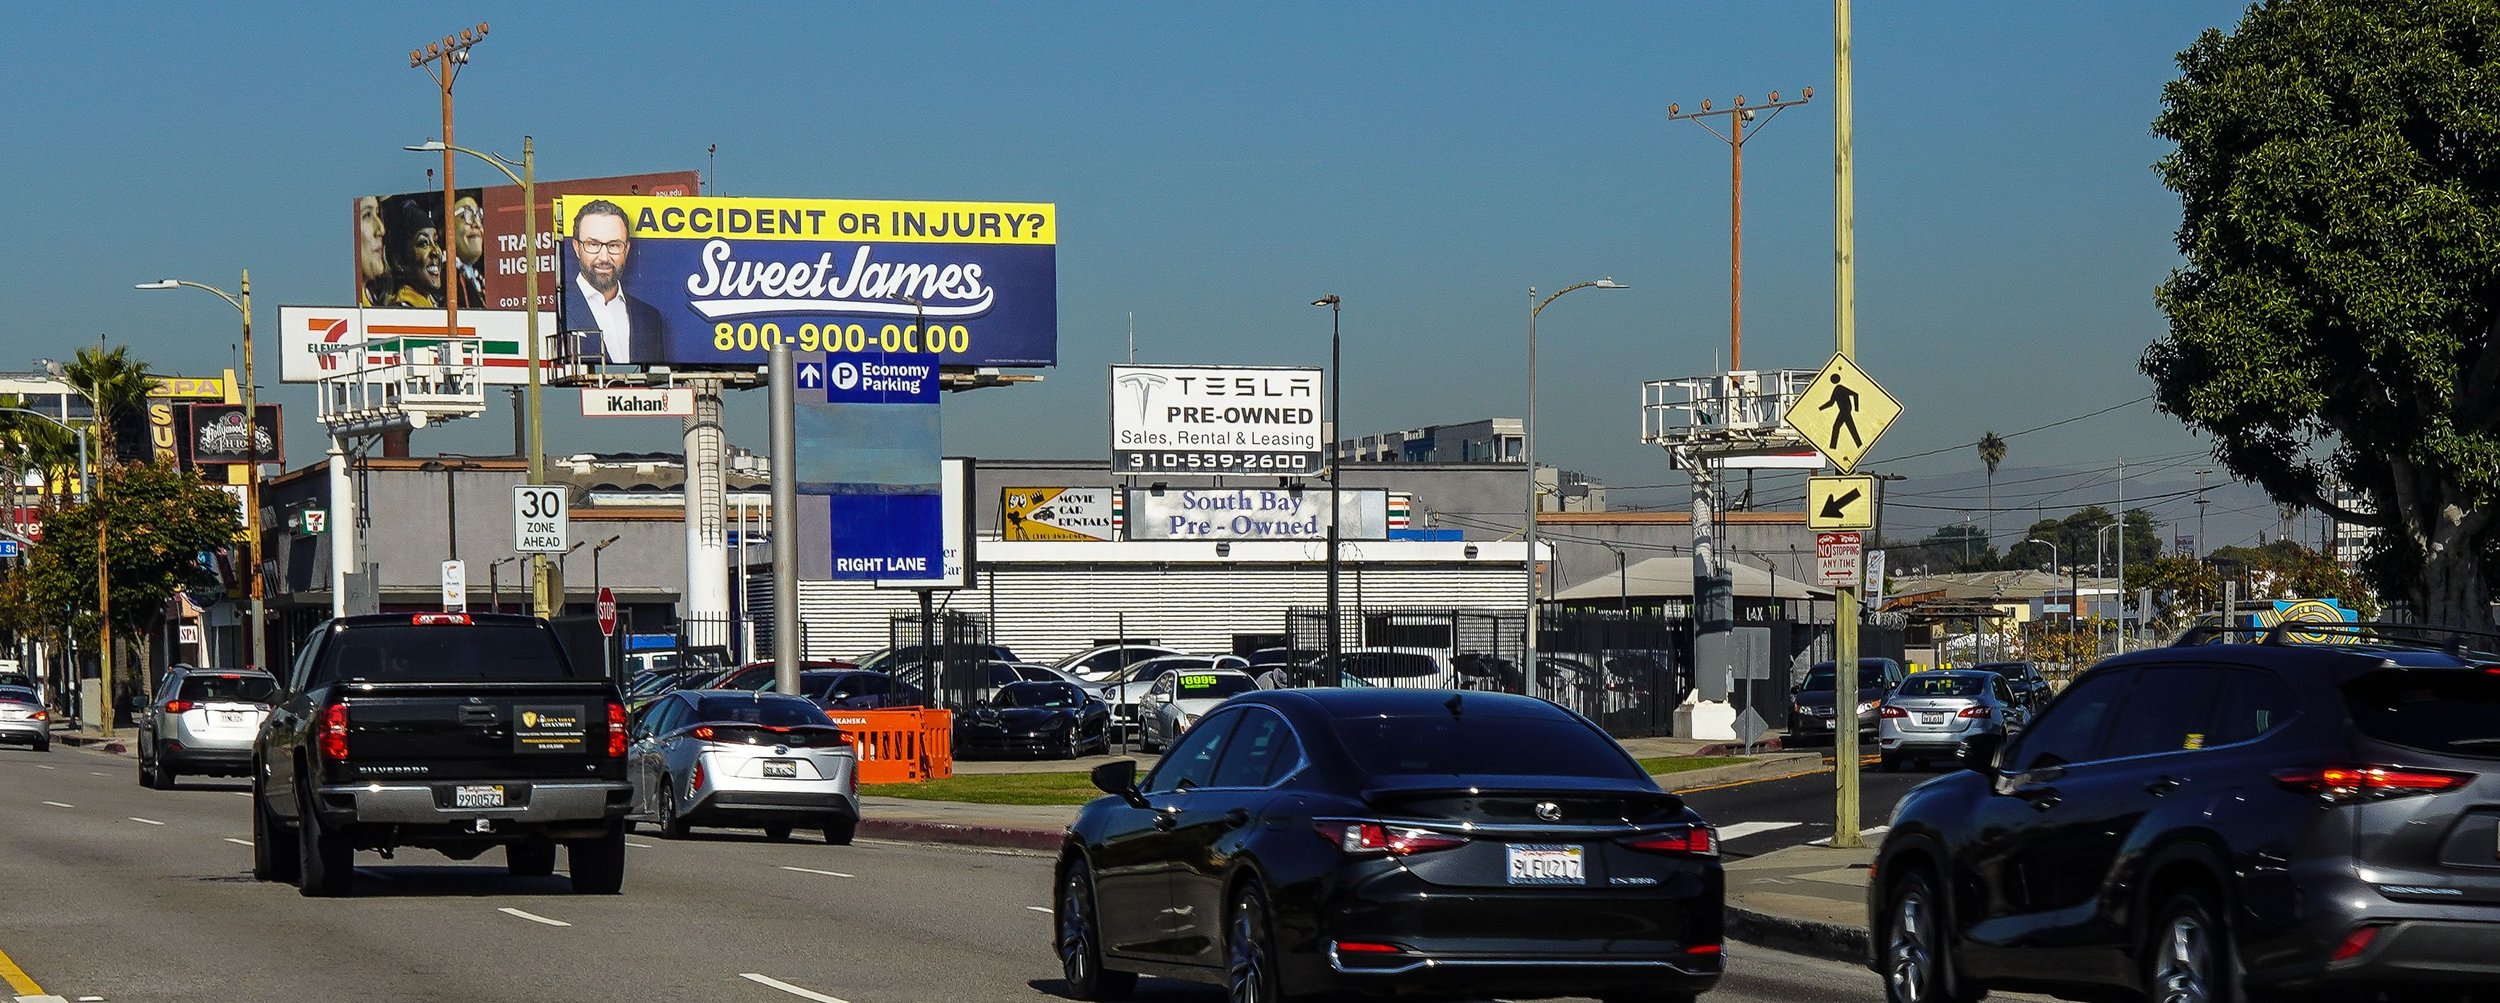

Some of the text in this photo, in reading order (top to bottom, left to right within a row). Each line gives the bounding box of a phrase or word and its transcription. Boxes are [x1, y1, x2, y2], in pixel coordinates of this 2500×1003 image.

[634, 206, 1046, 239] ACCIDENT OR INJURY?
[498, 231, 556, 252] TRANS
[686, 239, 986, 300] Sweet James
[500, 297, 520, 308] GOD
[713, 322, 970, 353] 800-900-0000
[861, 361, 930, 380] Economy
[861, 377, 922, 395] Parking
[1174, 375, 1311, 398] TESLA
[607, 395, 661, 412] iKahan
[1167, 406, 1314, 425] PRE-OWNED
[1121, 430, 1315, 449] Sales, Rental & Leasing
[1130, 453, 1307, 469] 310-539-2600
[521, 490, 560, 518] 30
[1057, 494, 1096, 504] MOVIE
[1183, 489, 1302, 515] South Bay
[1059, 505, 1084, 515] CAR
[526, 522, 556, 533] ZONE
[1057, 517, 1110, 527] RENTALS
[1169, 515, 1211, 535] Pre
[1231, 514, 1318, 535] Owned
[5, 545, 16, 553] St
[523, 536, 561, 548] AHEAD
[1818, 544, 1860, 557] NO STOPPING
[837, 557, 927, 572] RIGHT LANE
[1823, 559, 1855, 568] ANY TIME
[599, 604, 615, 620] STOP
[1746, 607, 1763, 621] LAX
[181, 628, 197, 641] SPA
